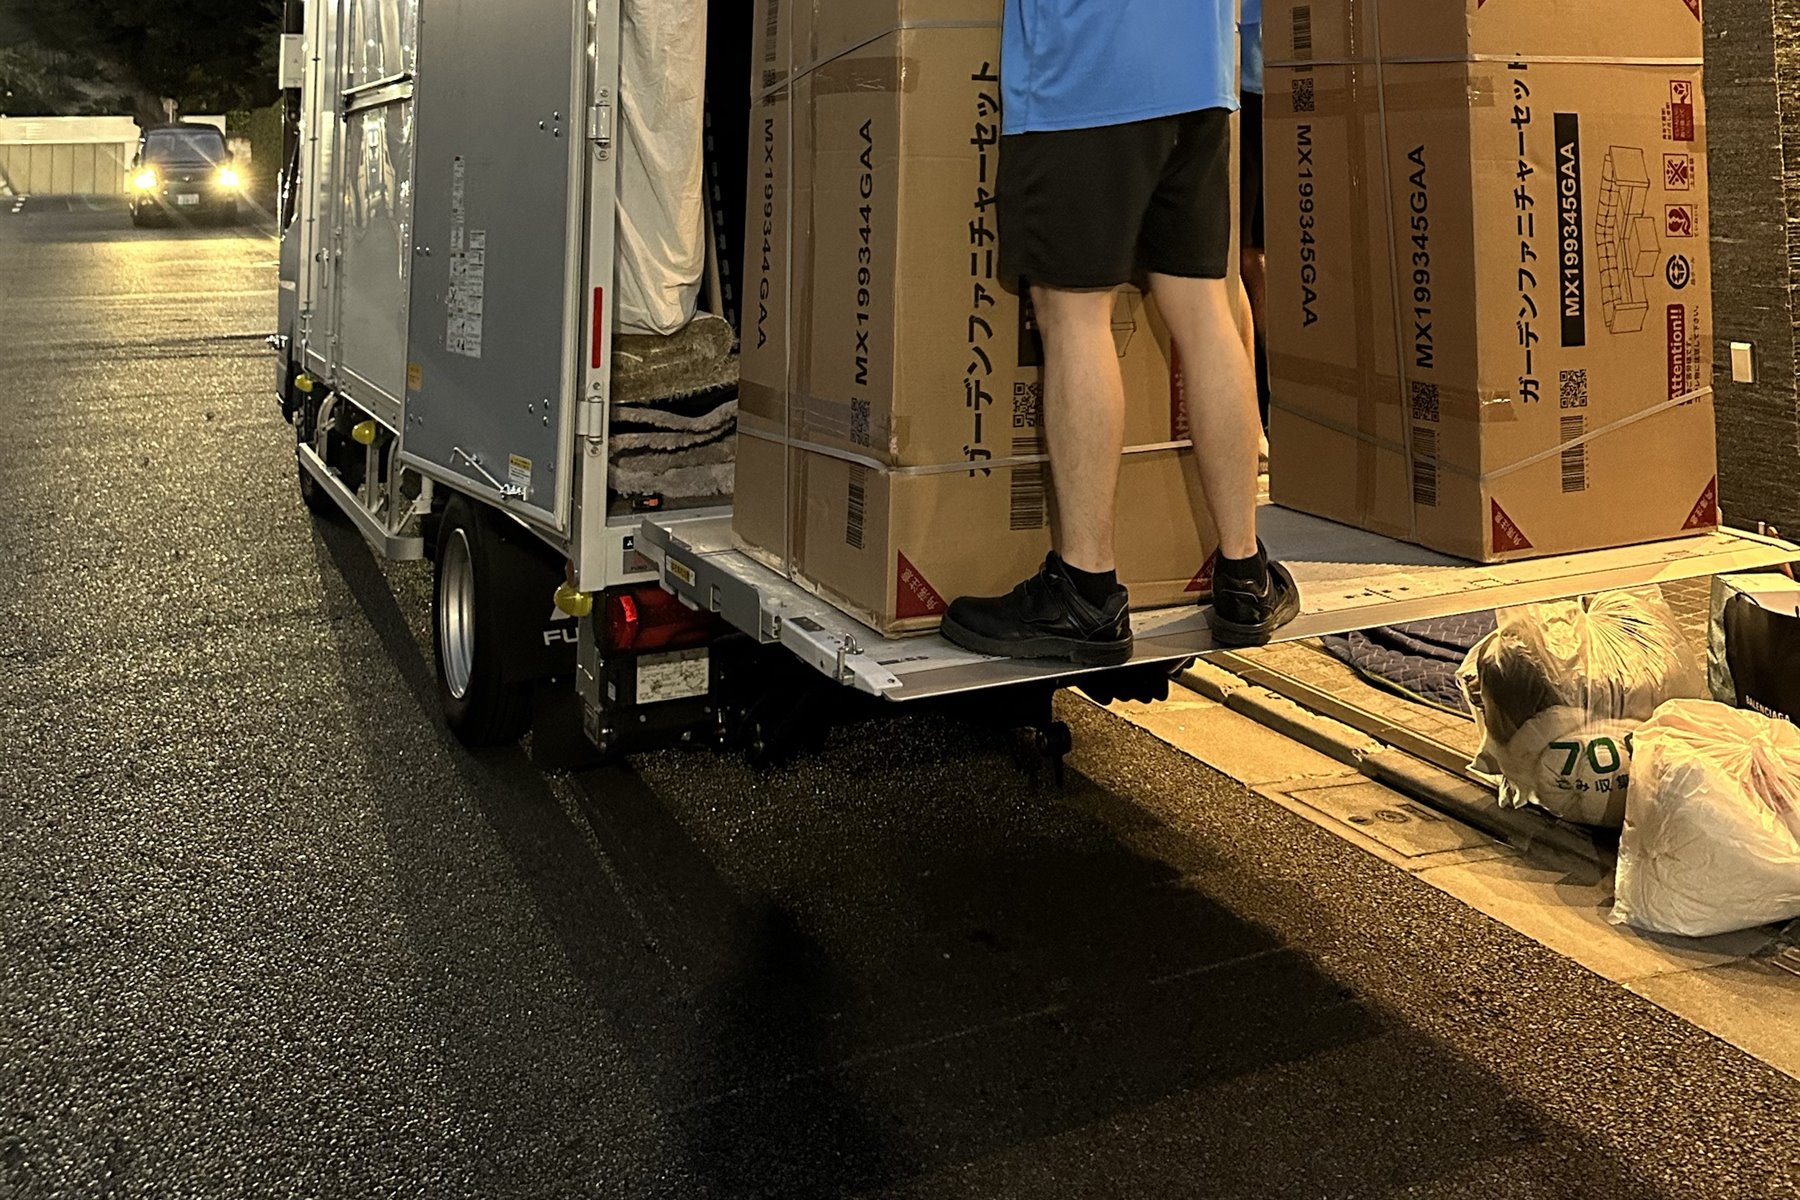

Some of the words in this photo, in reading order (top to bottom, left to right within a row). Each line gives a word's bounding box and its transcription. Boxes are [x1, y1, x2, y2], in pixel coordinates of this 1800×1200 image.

[757, 118, 774, 349] MX199344GAA
[855, 118, 873, 386] MX199344GAA
[963, 61, 999, 477] ガーデンファニチャーセット
[1297, 125, 1318, 328] MX199345GAA
[1408, 145, 1434, 368] MX199345GAA
[1508, 52, 1542, 403] ガーデンファニチャーセット
[1560, 142, 1581, 317] MX199345GAA
[1548, 732, 1634, 776] 70
